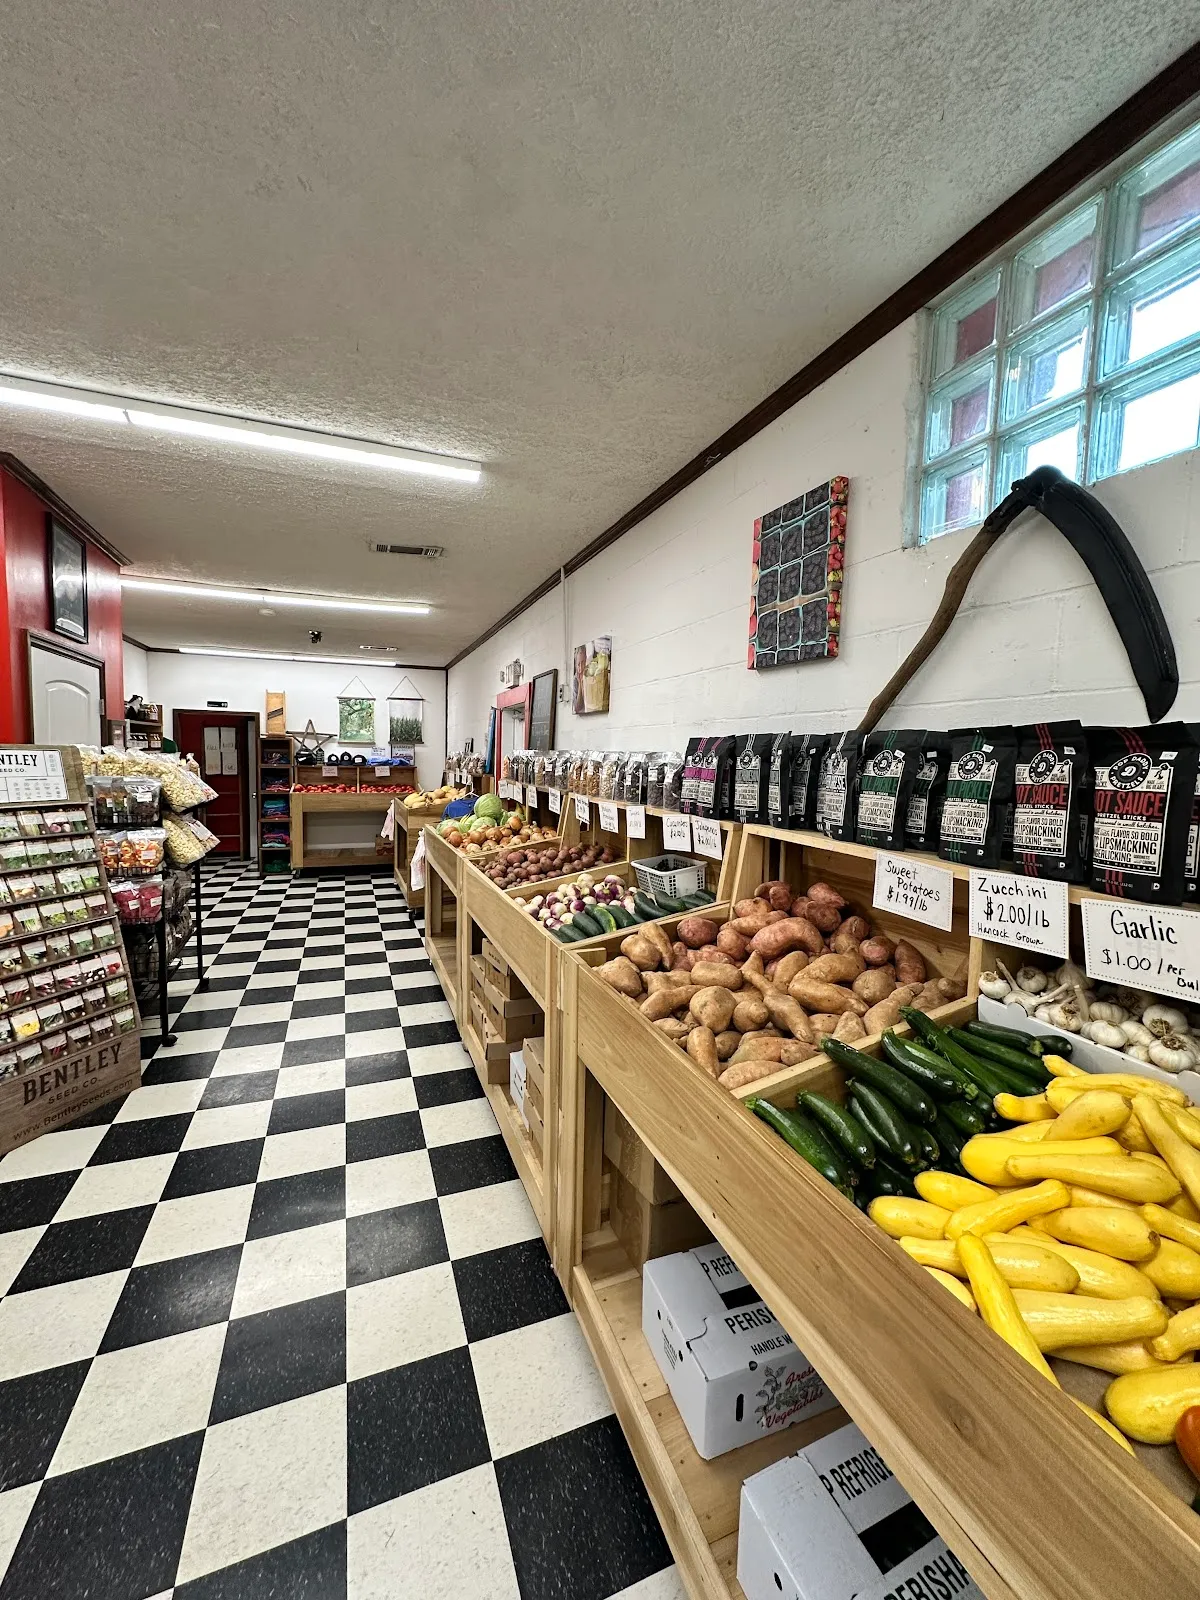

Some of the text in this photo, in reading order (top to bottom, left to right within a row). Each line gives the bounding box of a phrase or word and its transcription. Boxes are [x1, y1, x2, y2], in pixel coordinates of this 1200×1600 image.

[1112, 756, 1149, 770] POP DADDY
[1110, 776, 1144, 789] PRETZELS
[1030, 784, 1068, 805] SAUCE
[1114, 791, 1166, 816] SAUCE
[1049, 818, 1063, 826] BOLD
[1099, 836, 1156, 855] LIPSMACKING
[1111, 829, 1159, 842] FLAVOR SO BOLD
[885, 860, 918, 880] Sweet
[887, 885, 928, 911] $1.99/lb
[897, 876, 940, 902] Potatoes
[978, 877, 1047, 899] Zucchini
[978, 922, 1009, 938] Hancock
[1111, 910, 1178, 944] Garlic
[1016, 932, 1044, 945] Grown
[22, 1042, 122, 1105] BENTLEY
[48, 1076, 101, 1104] SEED CO.
[12, 1078, 133, 1142] www.BentleySeeds.com
[751, 1336, 784, 1356] HANDLE
[766, 1389, 824, 1428] Vegetables
